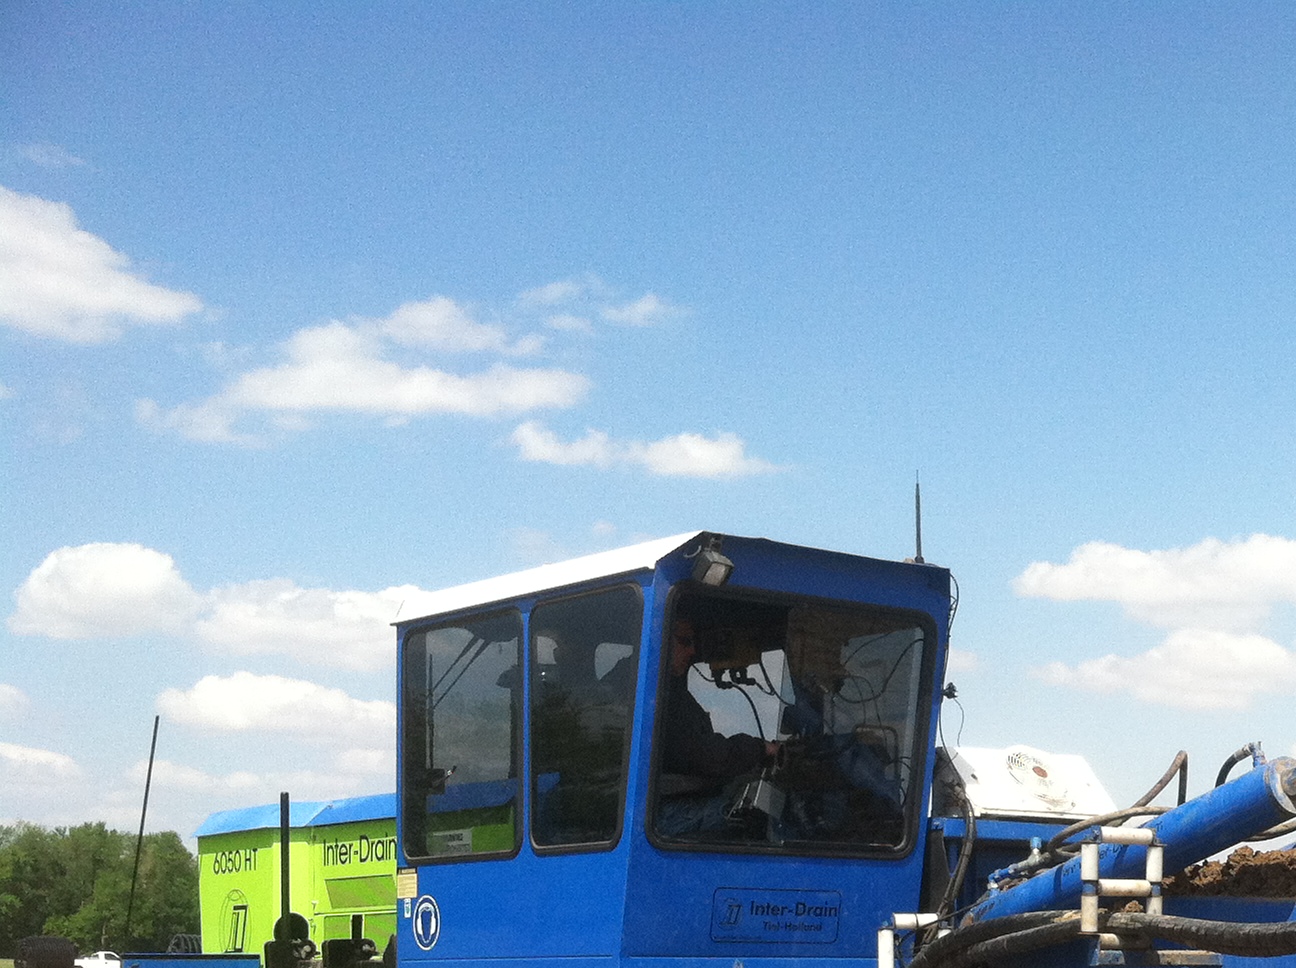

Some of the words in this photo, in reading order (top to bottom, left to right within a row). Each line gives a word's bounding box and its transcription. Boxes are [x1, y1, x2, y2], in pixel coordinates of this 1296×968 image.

[213, 850, 242, 875] 6050
[244, 848, 258, 872] HT
[323, 833, 396, 867] Inter-Drain
[750, 900, 838, 918] Inter-Drain
